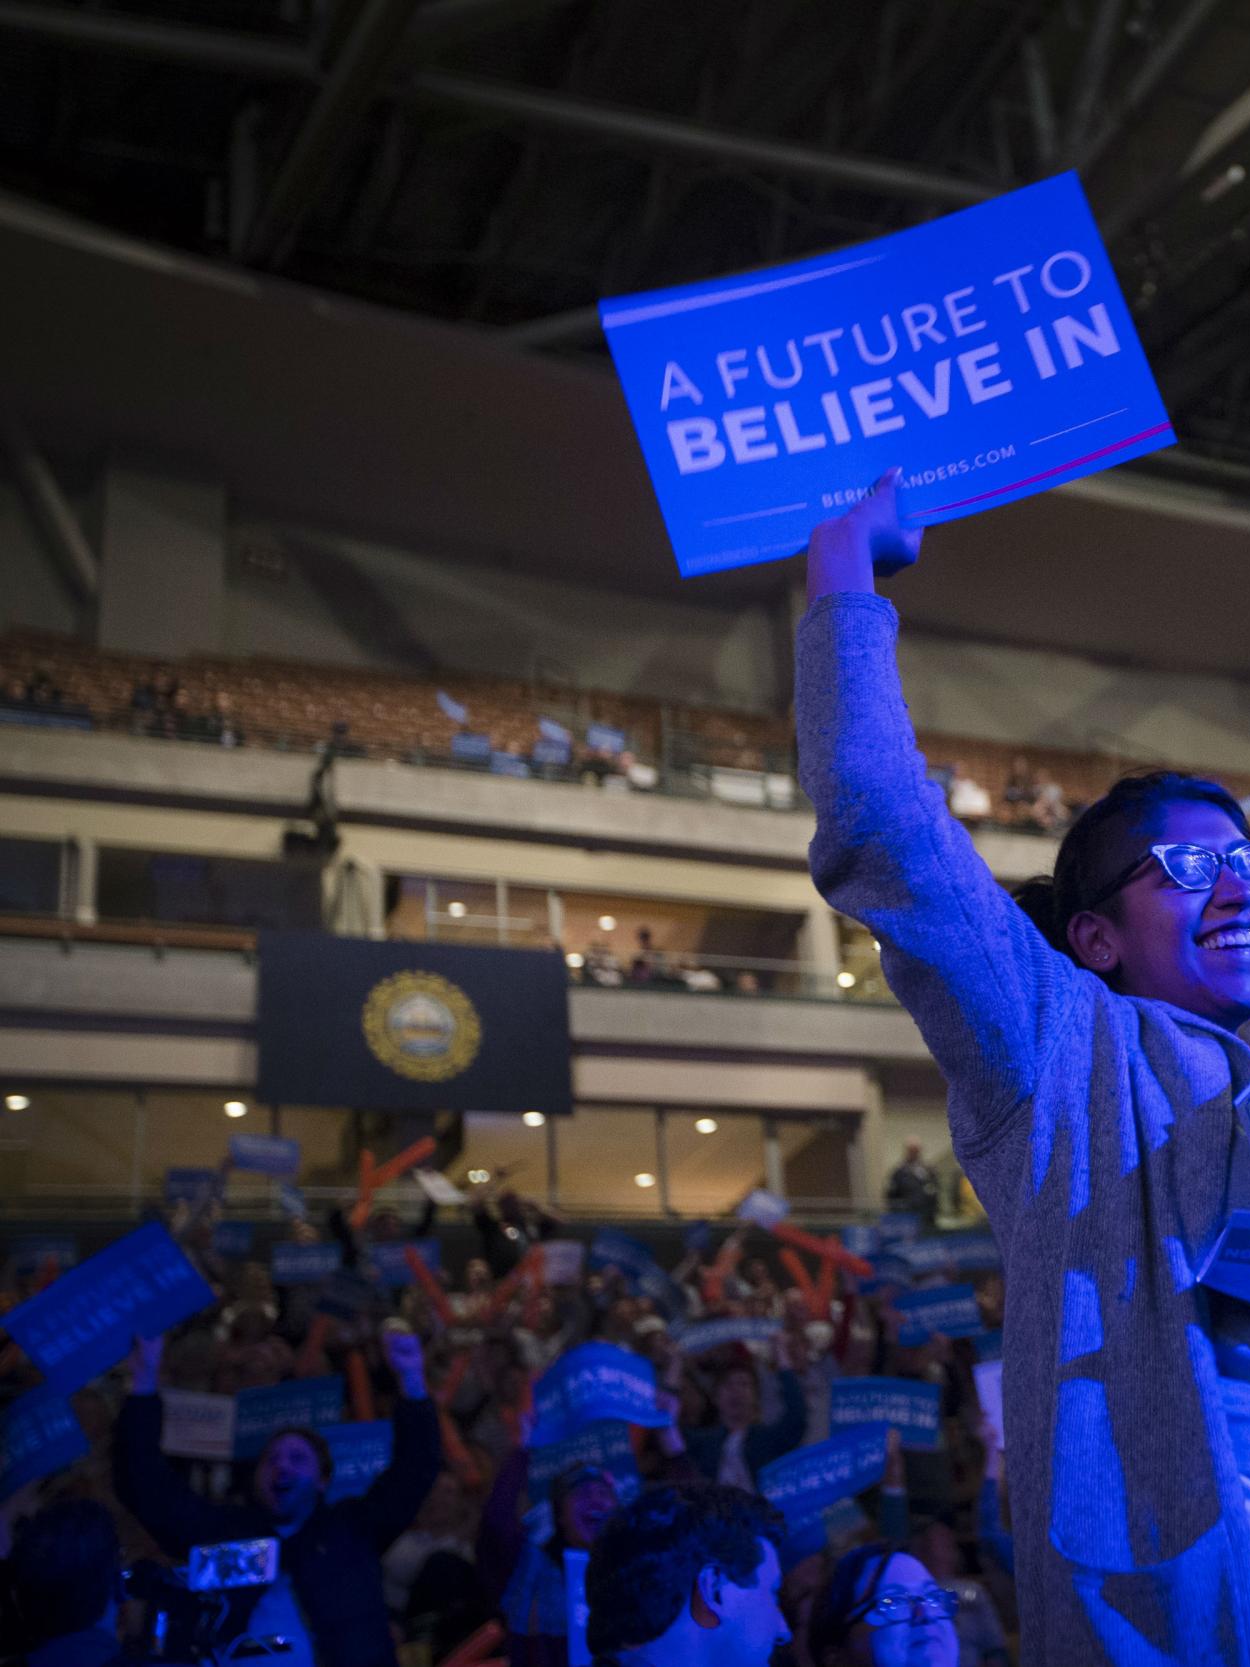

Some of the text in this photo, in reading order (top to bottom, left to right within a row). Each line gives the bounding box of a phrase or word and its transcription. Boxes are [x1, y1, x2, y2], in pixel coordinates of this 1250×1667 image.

[659, 249, 1092, 412] A FUTURE TO
[666, 303, 1122, 476] BELIEVE IN
